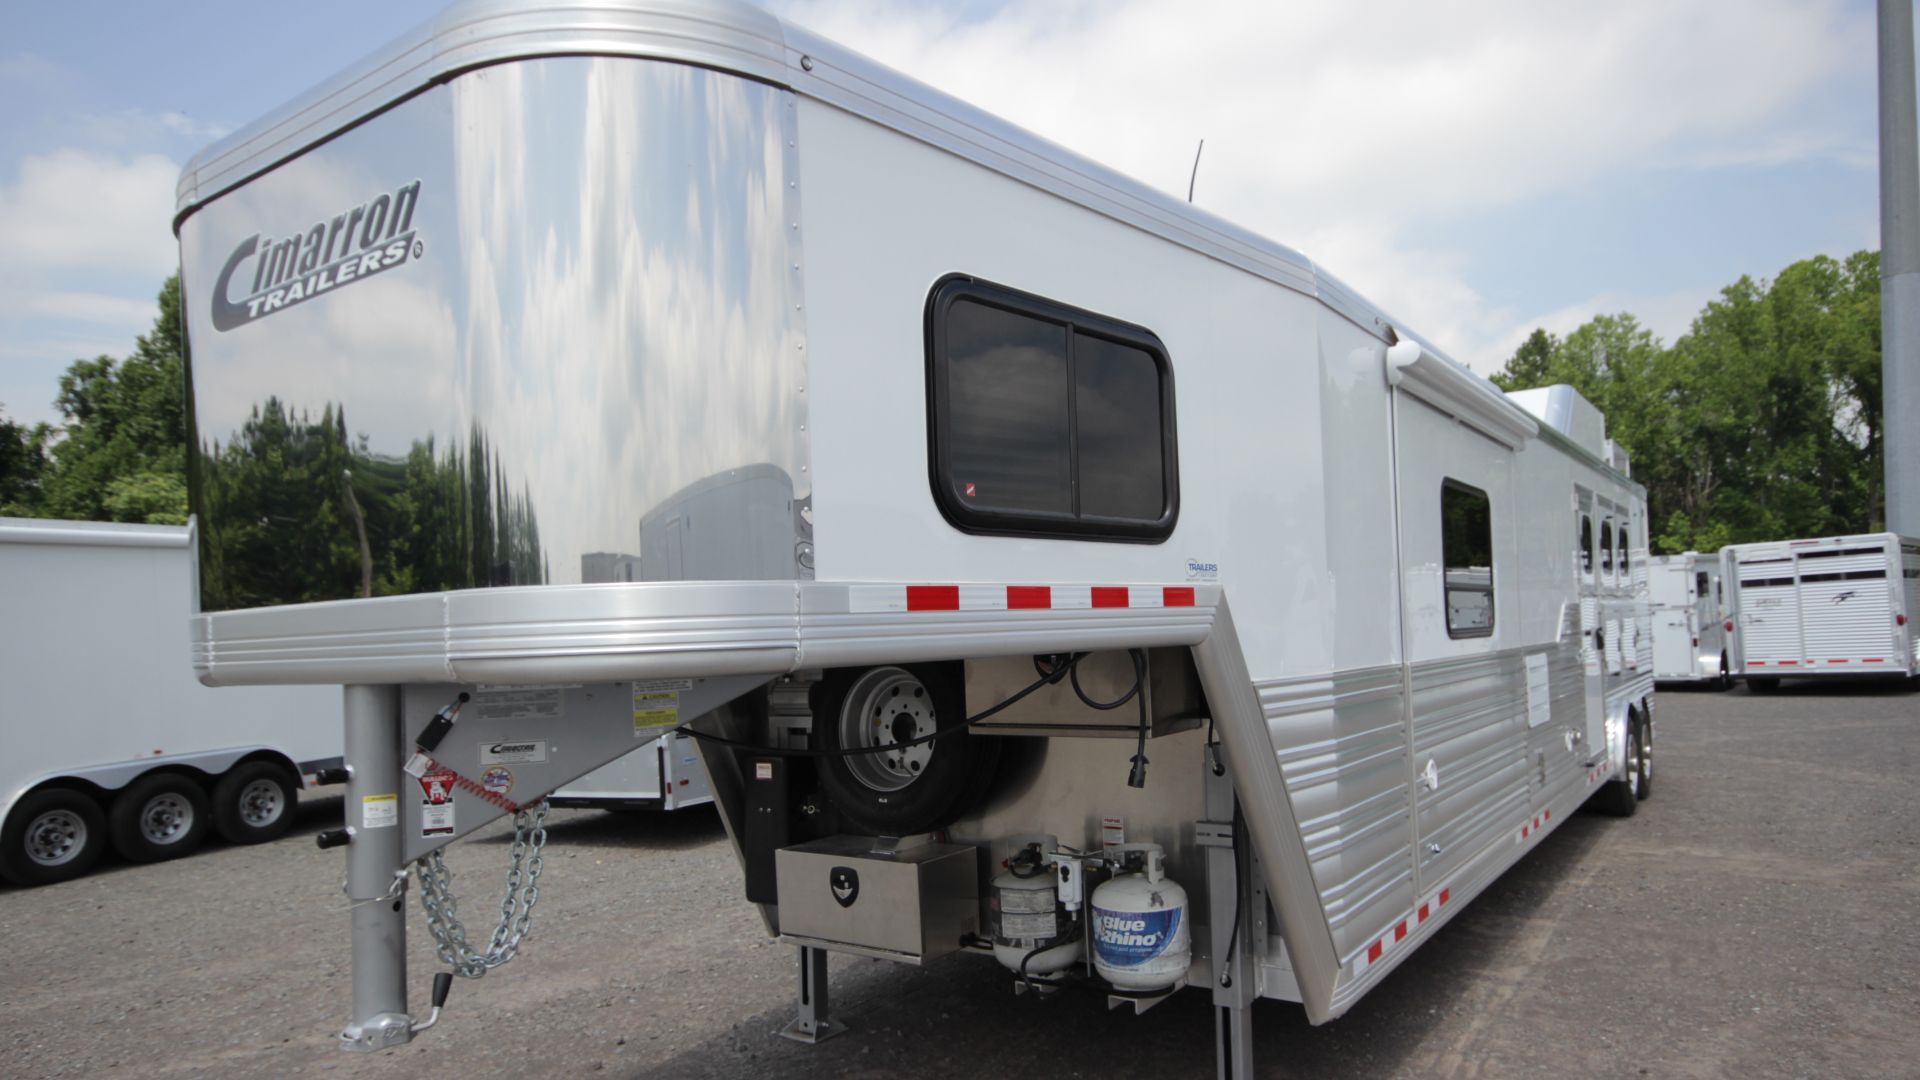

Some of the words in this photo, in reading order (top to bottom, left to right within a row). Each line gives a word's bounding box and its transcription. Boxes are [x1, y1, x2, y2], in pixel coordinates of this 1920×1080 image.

[211, 180, 421, 333] Cimarron
[247, 240, 407, 318] TRAILERS
[1103, 915, 1146, 932] Blue
